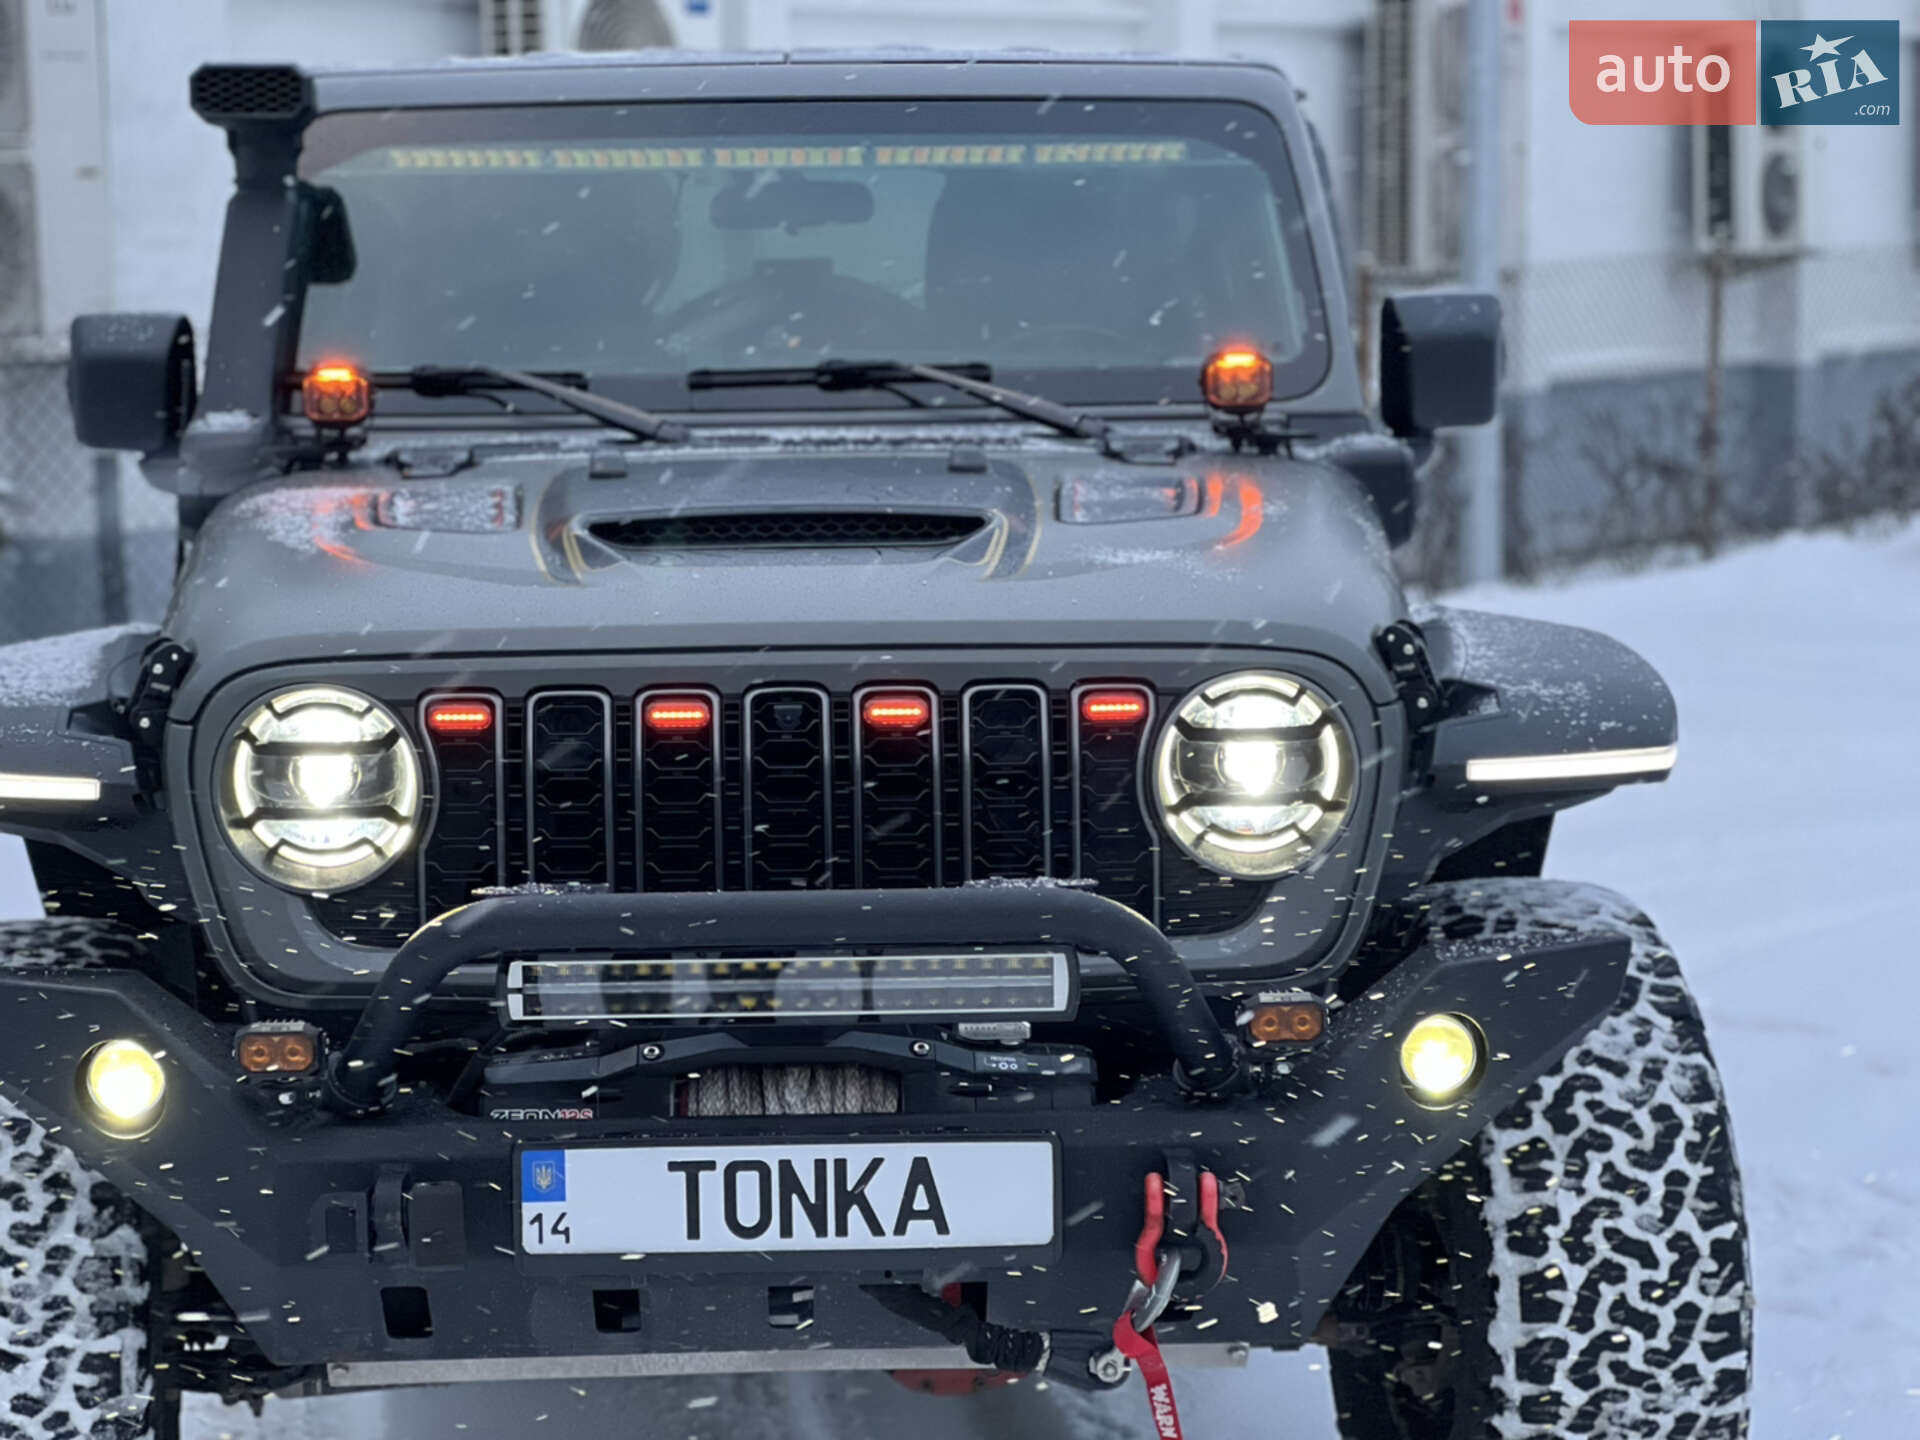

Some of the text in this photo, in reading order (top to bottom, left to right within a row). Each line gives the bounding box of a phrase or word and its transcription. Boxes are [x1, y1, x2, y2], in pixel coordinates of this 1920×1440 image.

[667, 1156, 951, 1240] TONKA
[529, 1211, 570, 1245] 14
[1150, 1383, 1178, 1439] WARN
